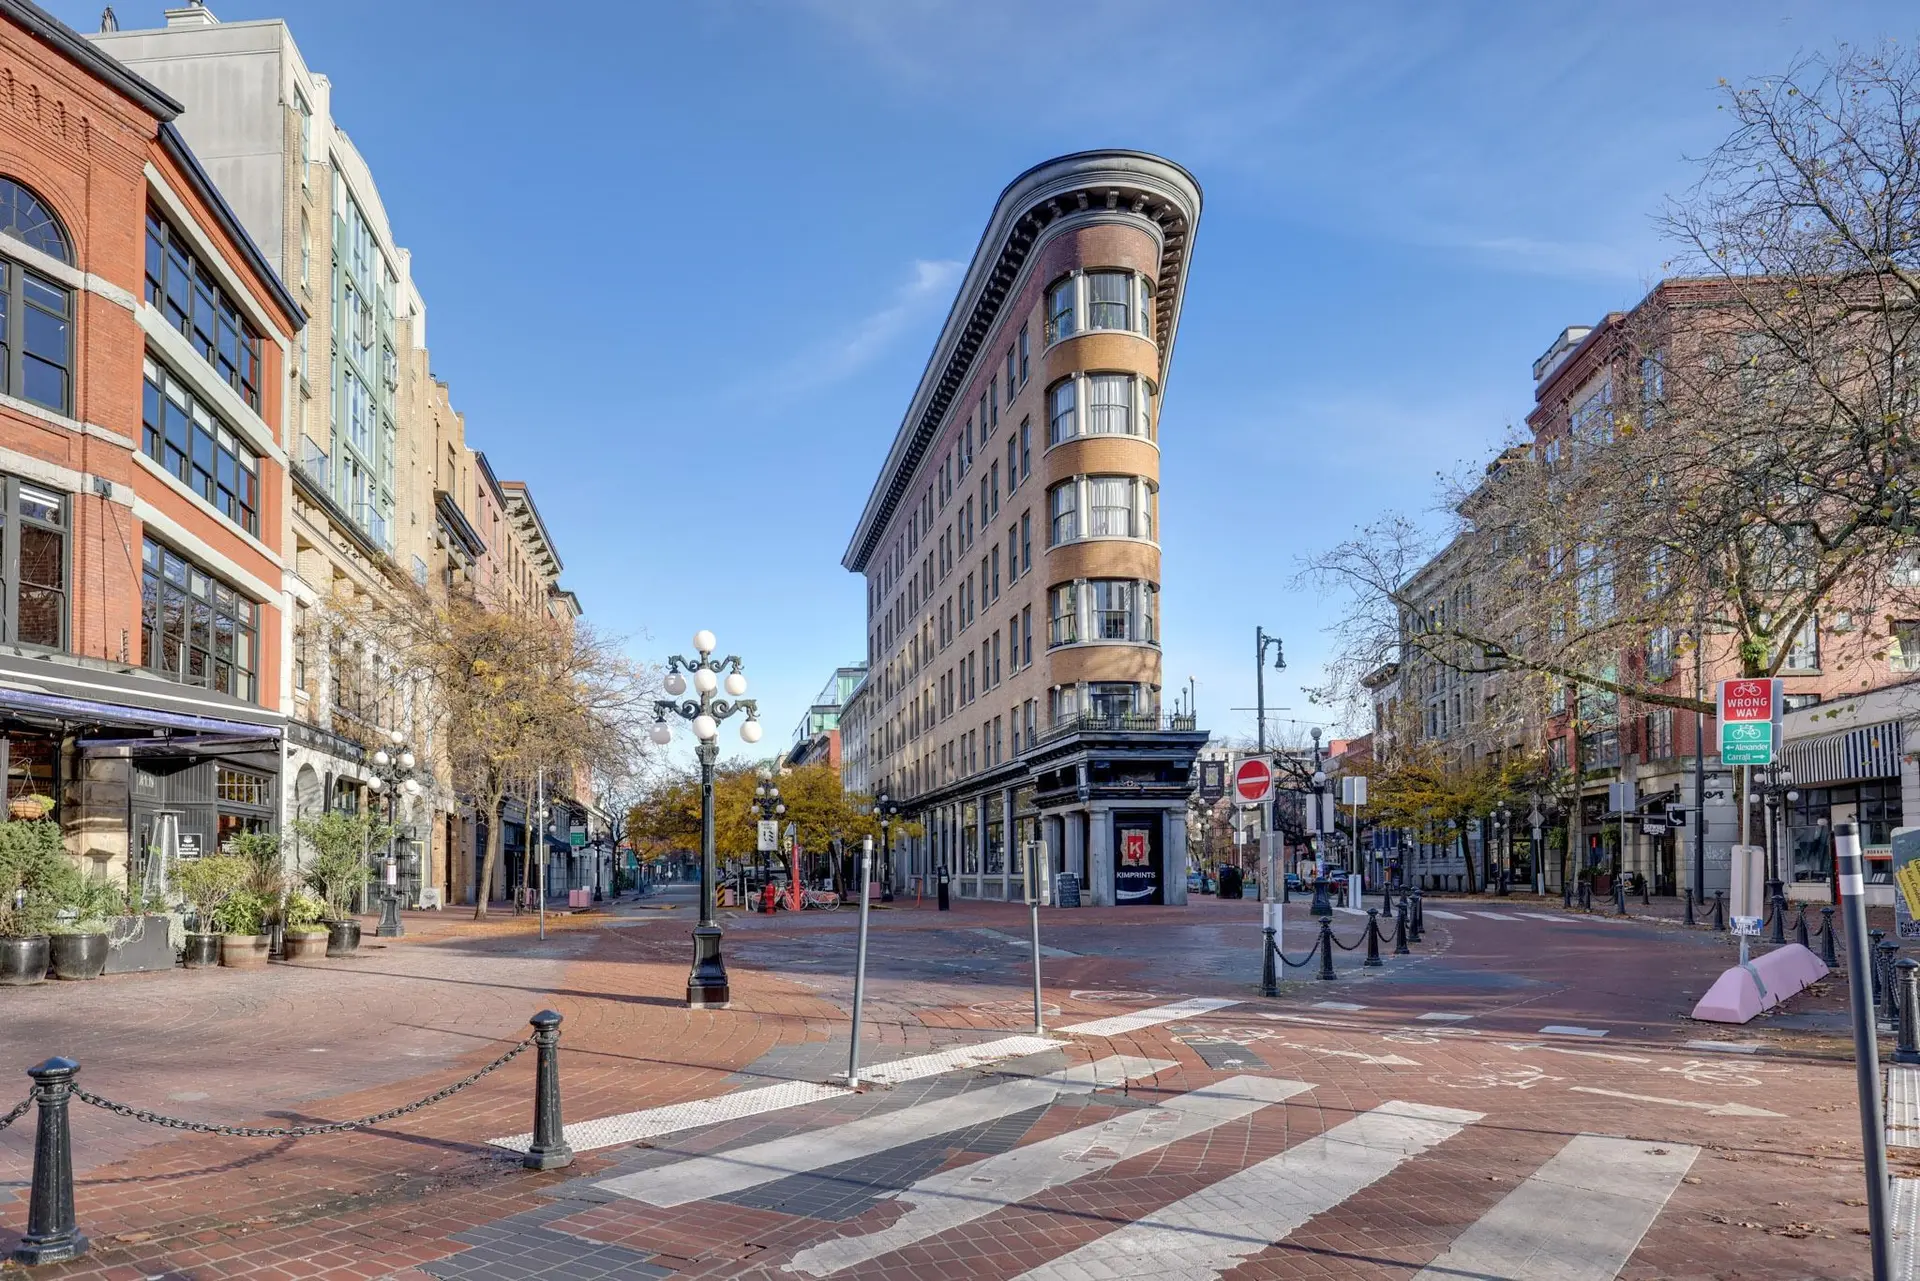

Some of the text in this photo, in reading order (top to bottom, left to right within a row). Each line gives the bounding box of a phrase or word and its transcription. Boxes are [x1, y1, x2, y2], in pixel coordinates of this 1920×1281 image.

[1727, 697, 1768, 708] WRONG
[1736, 708, 1759, 718] WAY
[1116, 871, 1156, 879] KIMPRINTS
